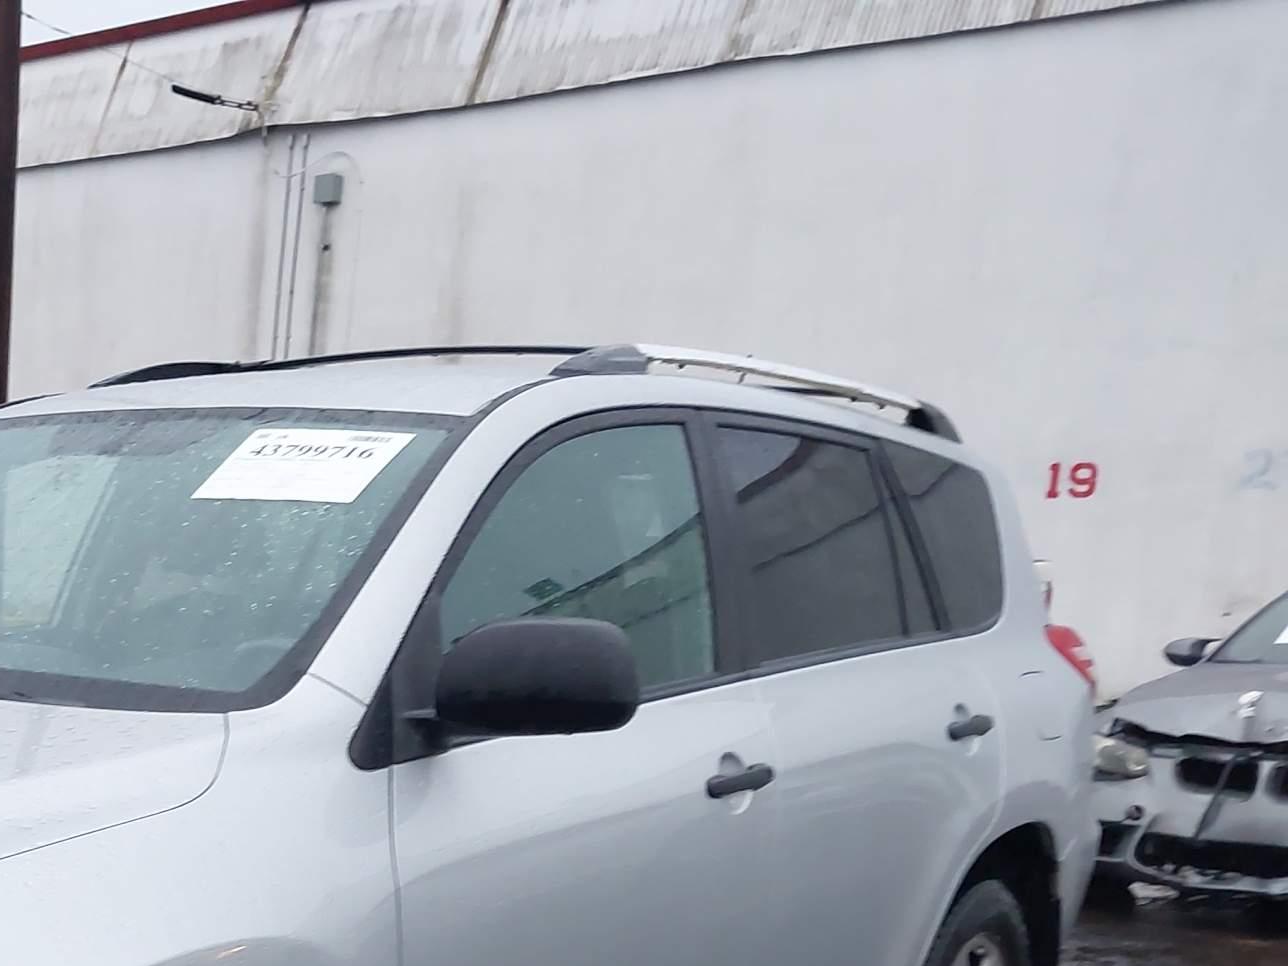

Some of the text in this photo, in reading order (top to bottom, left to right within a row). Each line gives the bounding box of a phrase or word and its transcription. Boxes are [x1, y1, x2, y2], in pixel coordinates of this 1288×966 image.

[250, 443, 375, 460] 43799716
[1239, 449, 1288, 490] 2
[1045, 461, 1099, 499] 19
